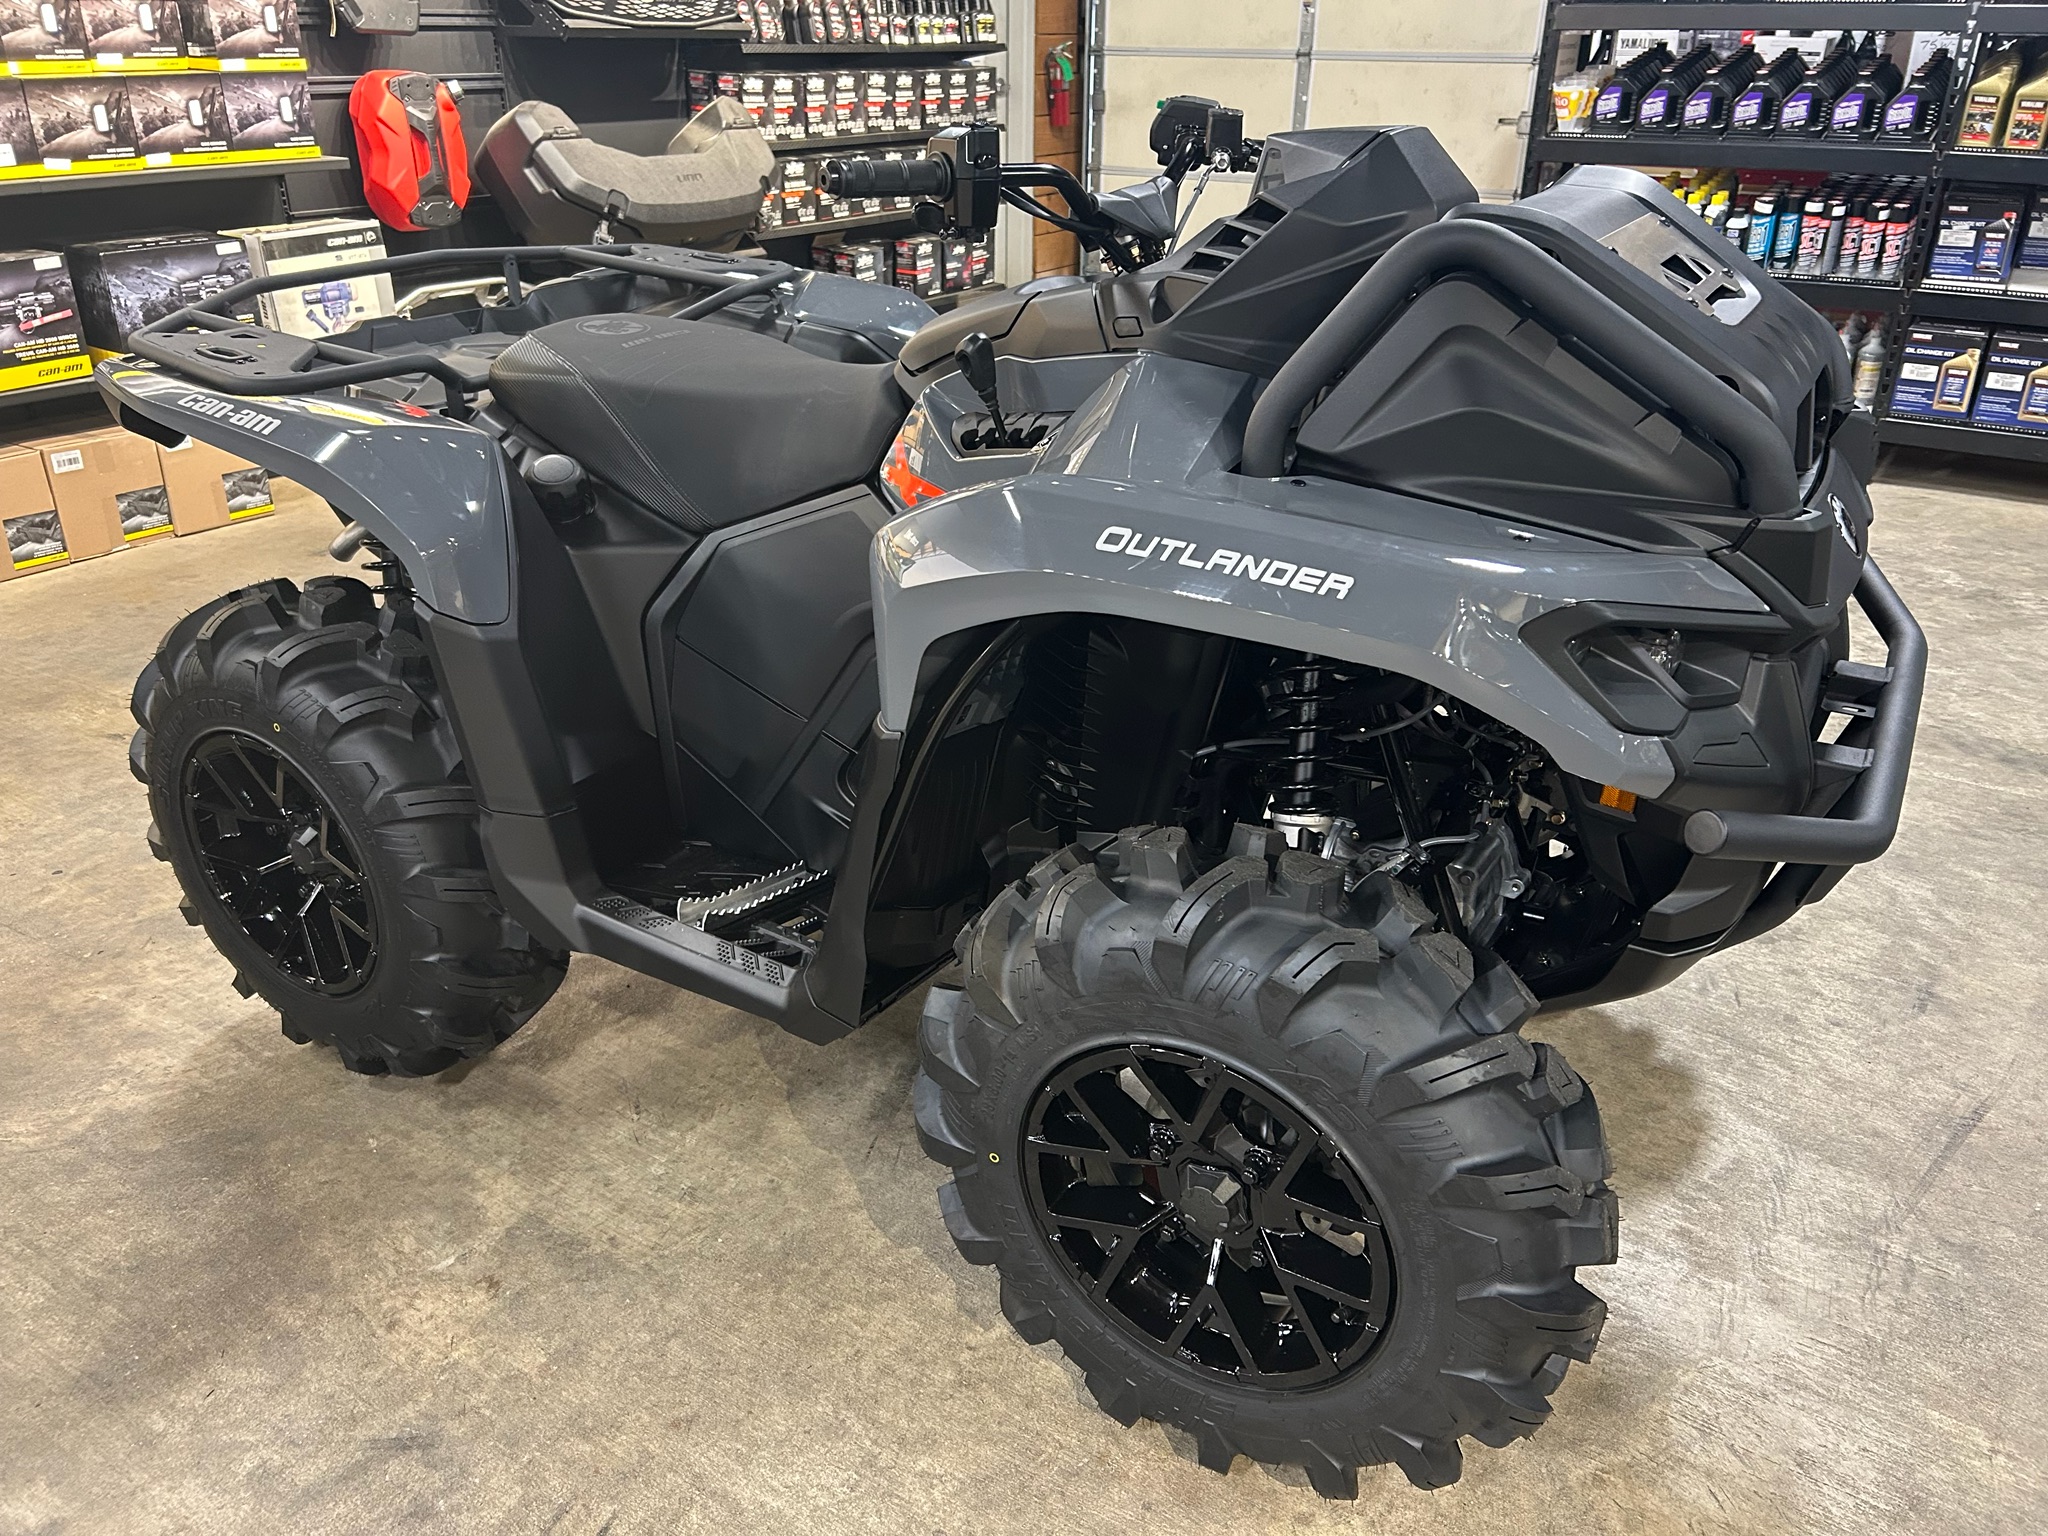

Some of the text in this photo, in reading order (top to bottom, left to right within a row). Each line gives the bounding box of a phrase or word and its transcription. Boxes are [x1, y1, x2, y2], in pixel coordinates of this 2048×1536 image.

[1621, 38, 1667, 49] YAMALUB
[326, 234, 363, 247] can-am
[1918, 348, 1944, 357] CHANGE
[1944, 350, 1956, 358] KIT
[38, 363, 83, 377] can-am
[177, 393, 282, 436] can-am
[1095, 525, 1355, 600] OUTLANDER
